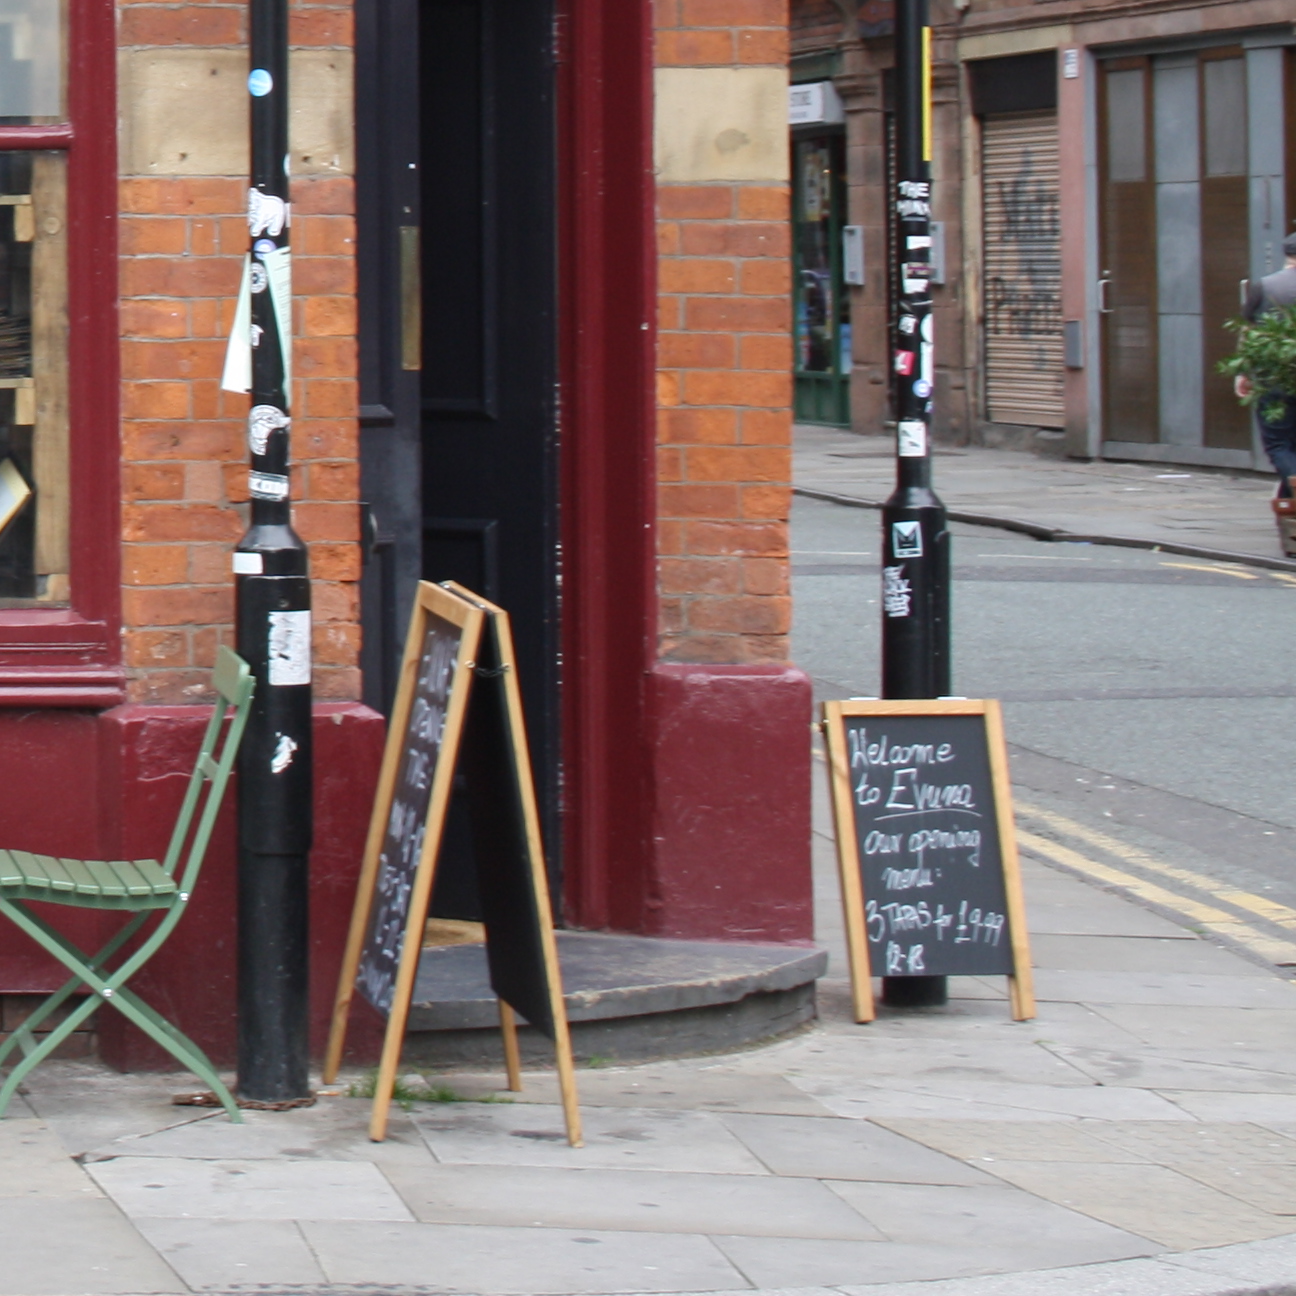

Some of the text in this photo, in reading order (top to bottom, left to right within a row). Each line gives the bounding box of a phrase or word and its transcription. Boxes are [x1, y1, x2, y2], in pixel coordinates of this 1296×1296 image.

[849, 728, 956, 768] Welcome
[855, 768, 975, 810] to Evuna
[908, 824, 981, 867] opening
[865, 900, 885, 942] 3
[881, 901, 932, 934] TAPAS
